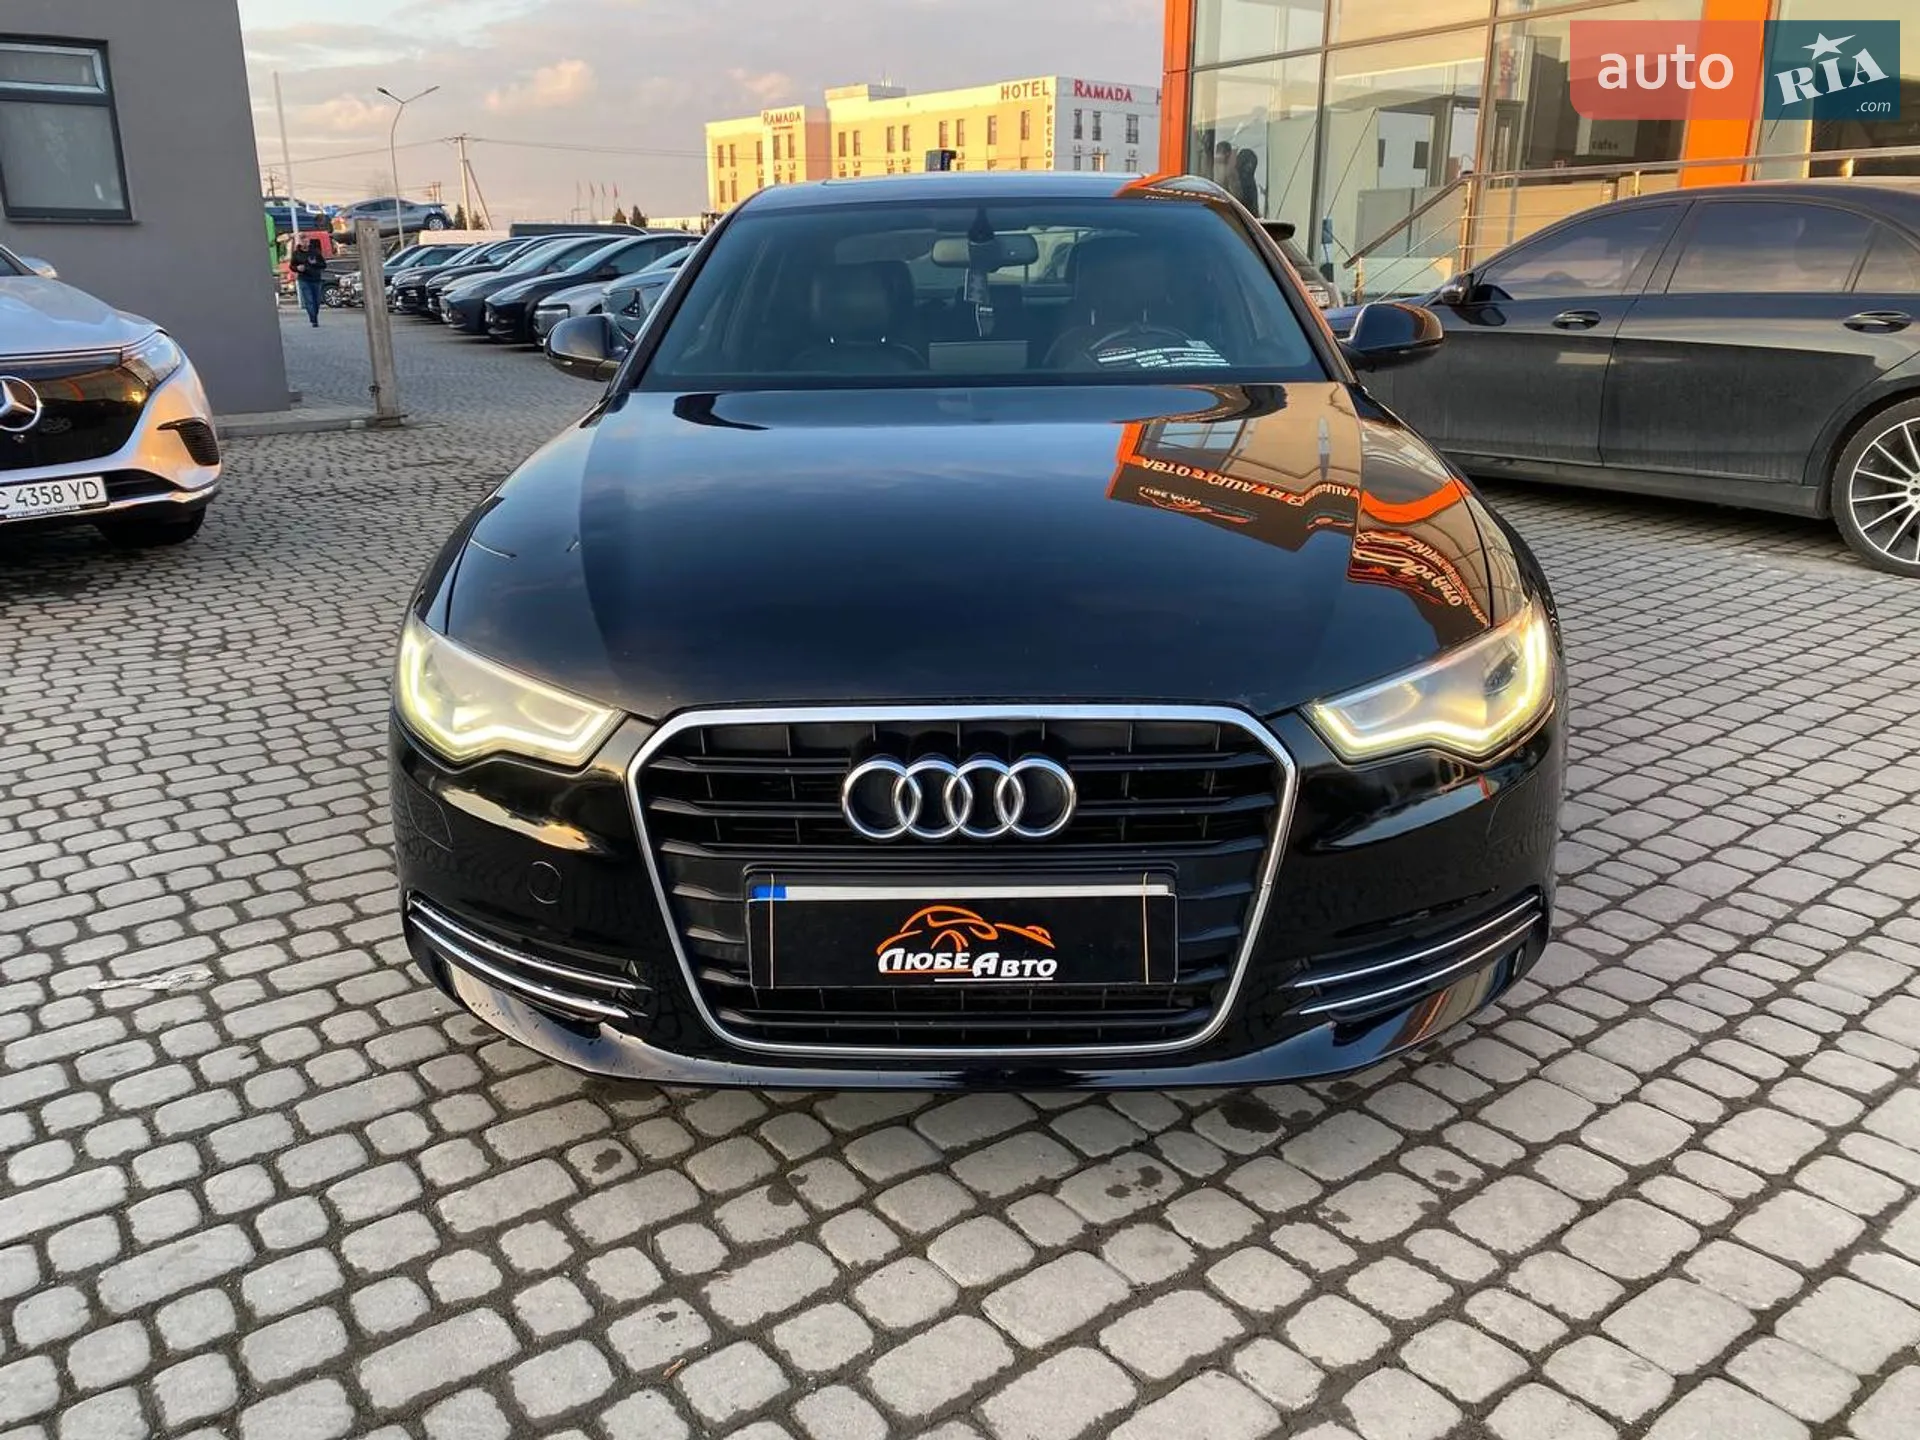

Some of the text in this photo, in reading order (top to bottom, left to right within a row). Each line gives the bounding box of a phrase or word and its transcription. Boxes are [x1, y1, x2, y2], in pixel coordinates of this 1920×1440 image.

[1000, 79, 1050, 100] HOTEL
[1073, 79, 1134, 103] RAMADA
[15, 484, 64, 507] 4358
[68, 481, 99, 502] YD
